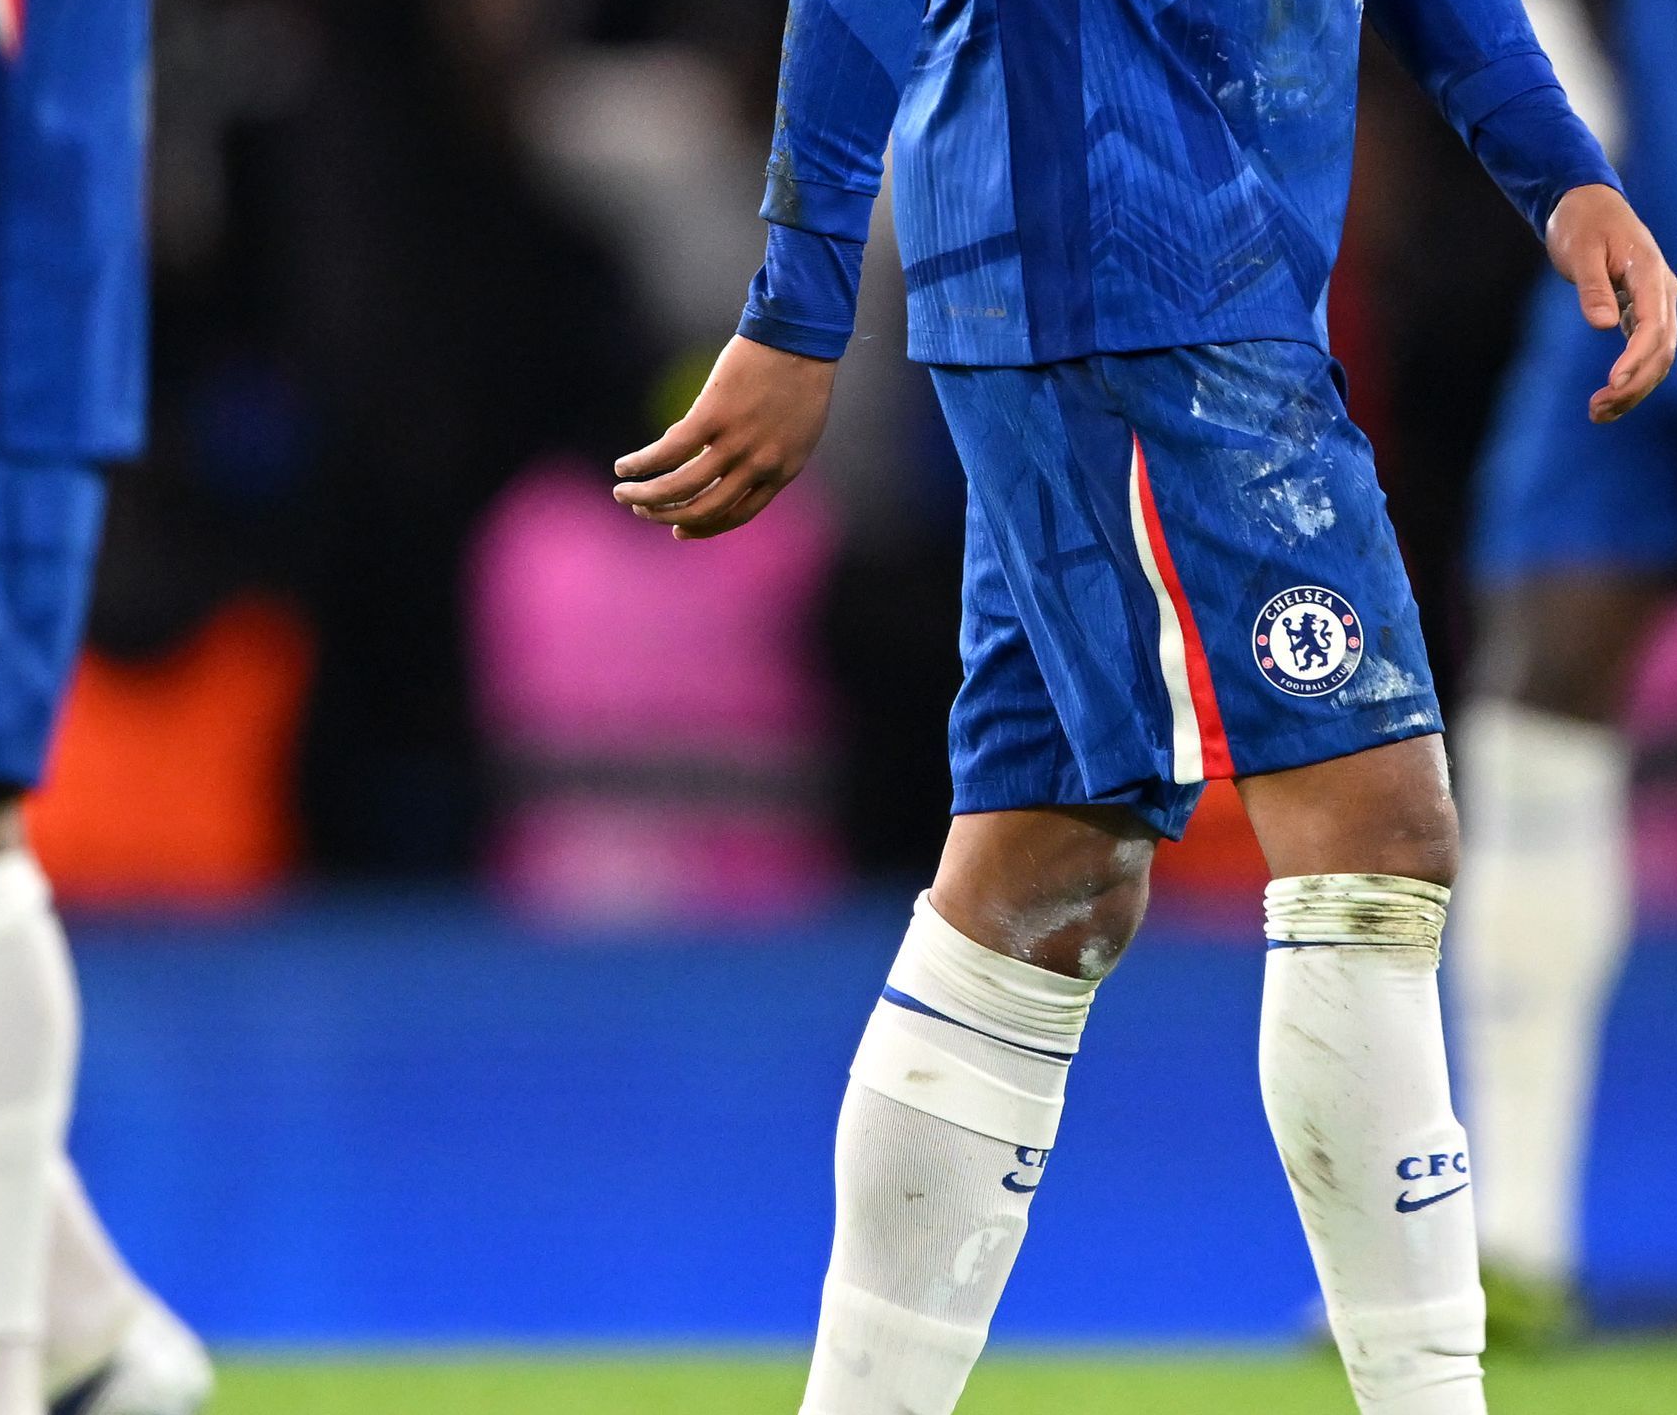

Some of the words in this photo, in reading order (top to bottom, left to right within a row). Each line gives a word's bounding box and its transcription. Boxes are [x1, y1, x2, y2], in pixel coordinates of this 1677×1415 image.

[1265, 590, 1333, 621] CHELSEA
[1280, 677, 1328, 692] FOOTBALL
[1396, 1152, 1467, 1180] CFC
